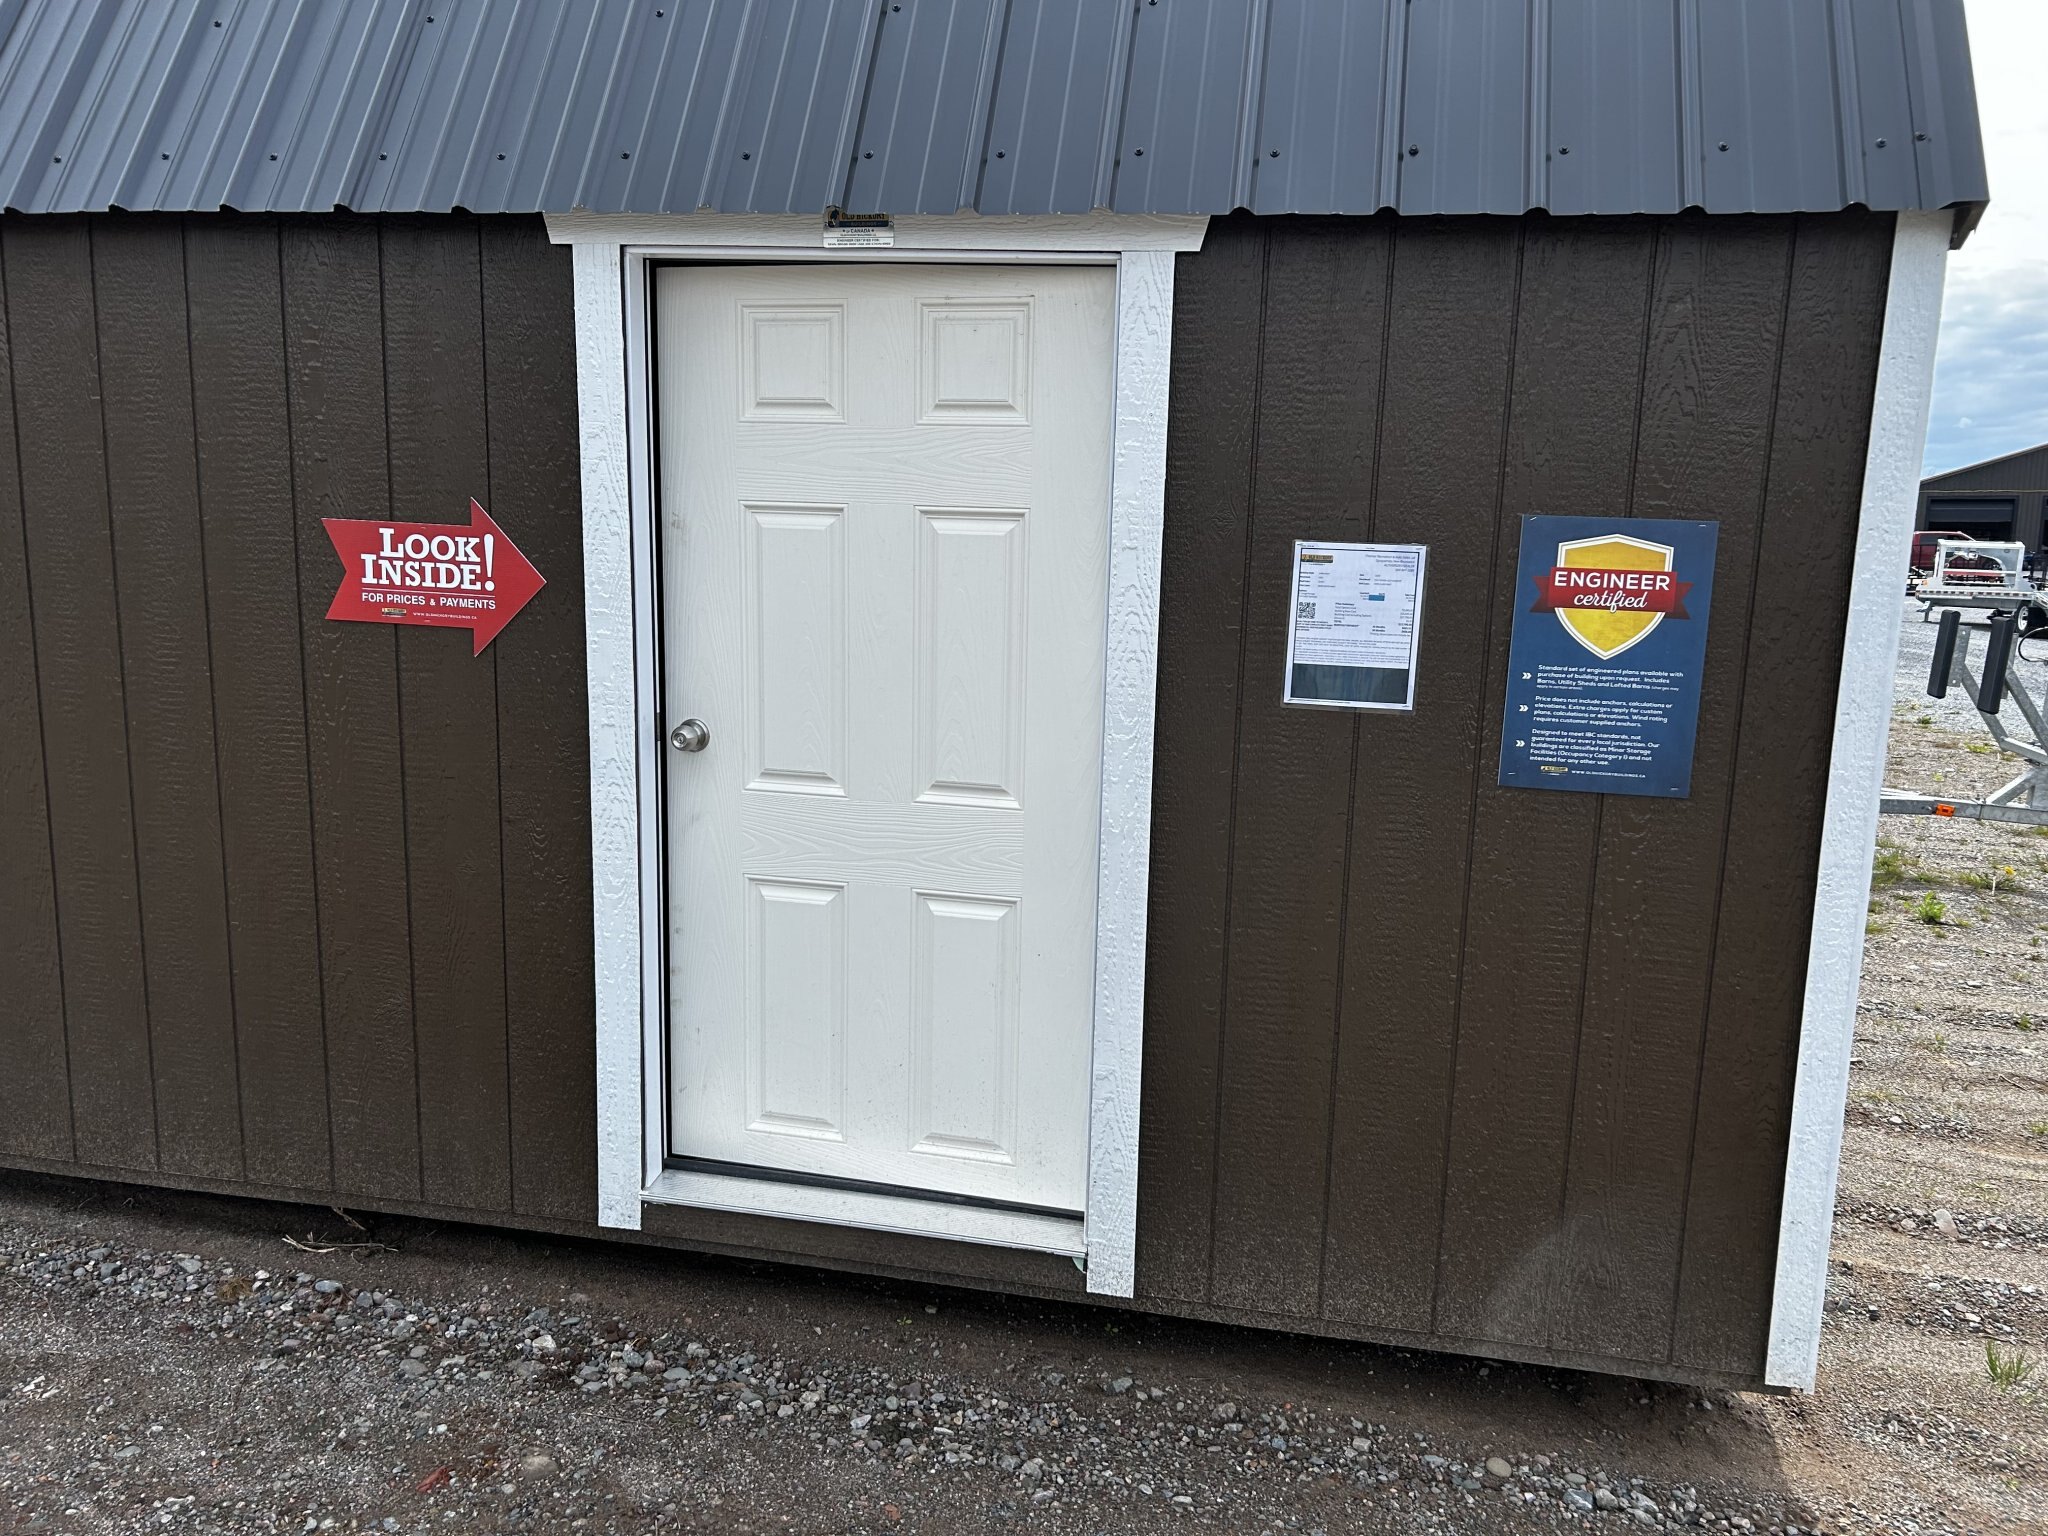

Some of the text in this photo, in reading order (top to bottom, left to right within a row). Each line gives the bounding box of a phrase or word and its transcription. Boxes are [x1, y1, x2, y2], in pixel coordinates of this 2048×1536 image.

[379, 527, 481, 563] LOOK
[361, 534, 495, 592] INSIDE!
[1554, 571, 1670, 591] ENGINEER
[362, 592, 496, 610] FOR PRICES & PAYMENTS
[1573, 590, 1648, 613] certified
[1558, 750, 1593, 758] (Occupancy
